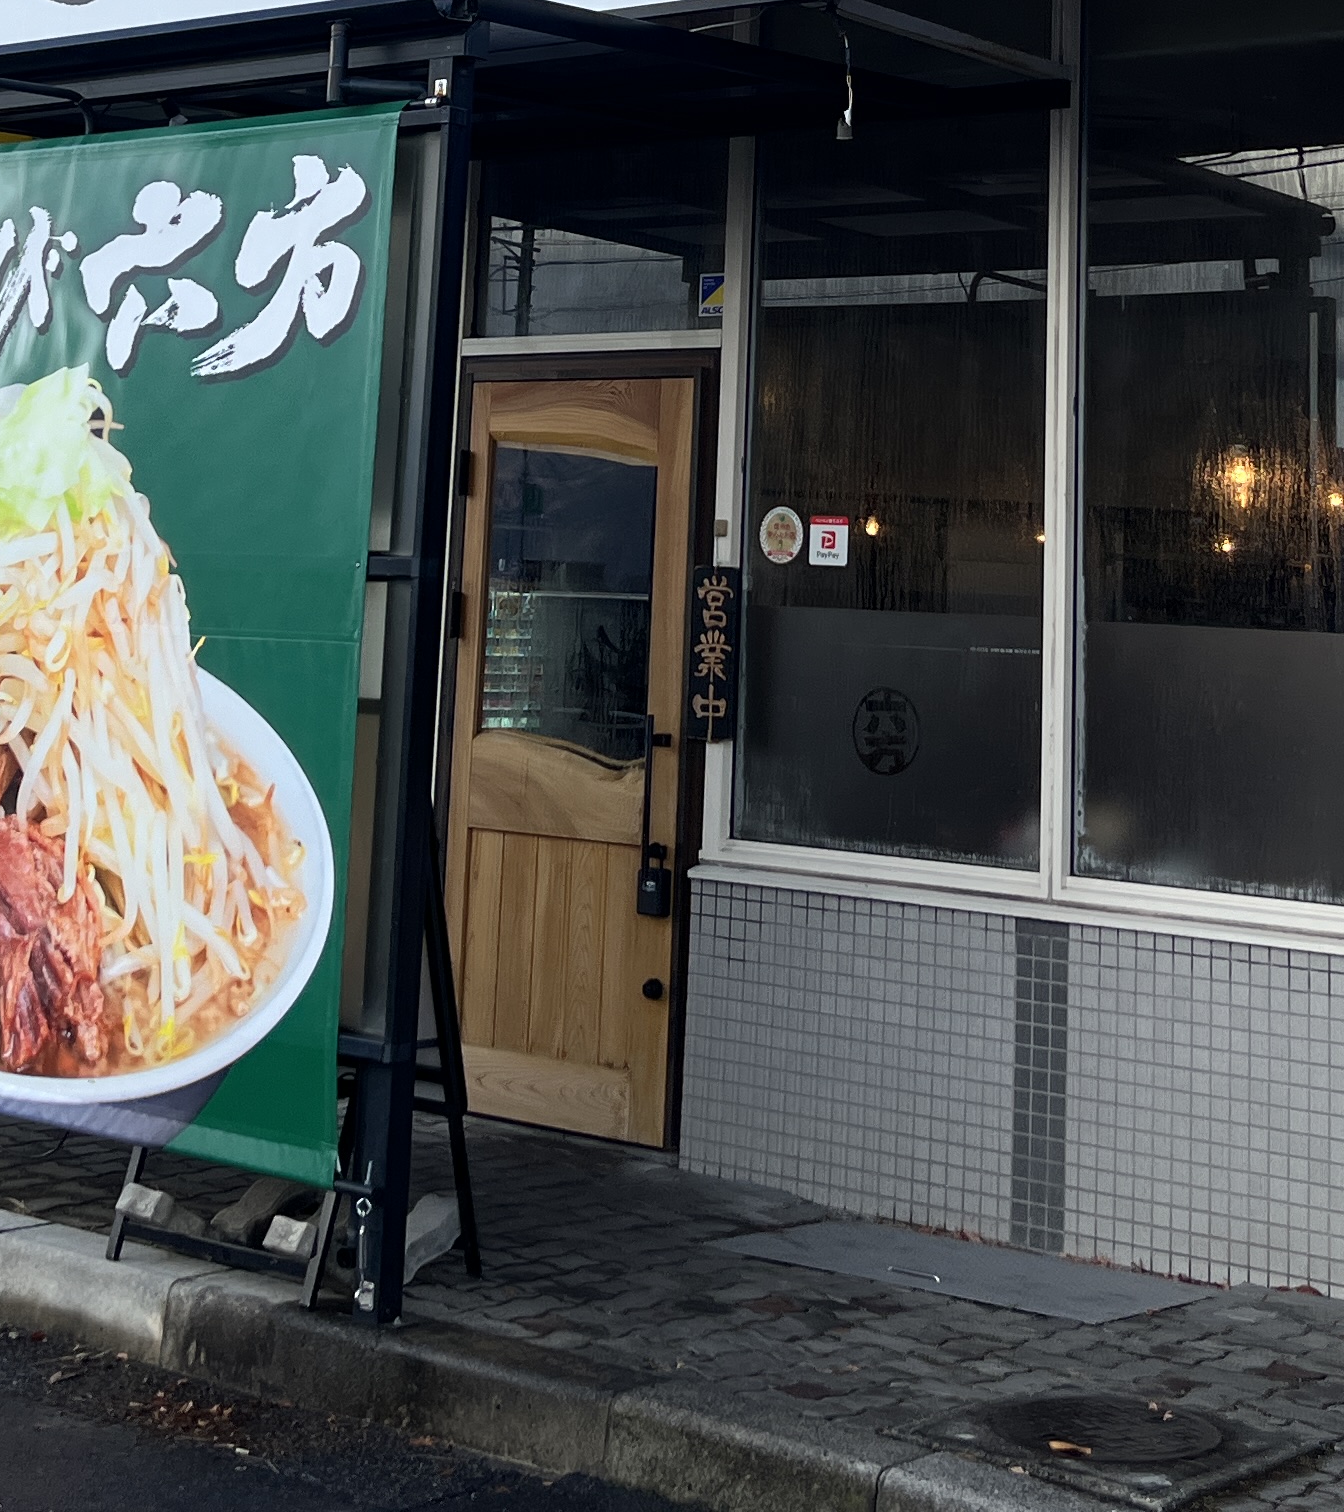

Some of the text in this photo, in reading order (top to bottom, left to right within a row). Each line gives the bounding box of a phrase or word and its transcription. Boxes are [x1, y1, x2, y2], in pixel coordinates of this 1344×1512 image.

[816, 550, 840, 560] PayPay
[692, 574, 734, 744] 営業中
